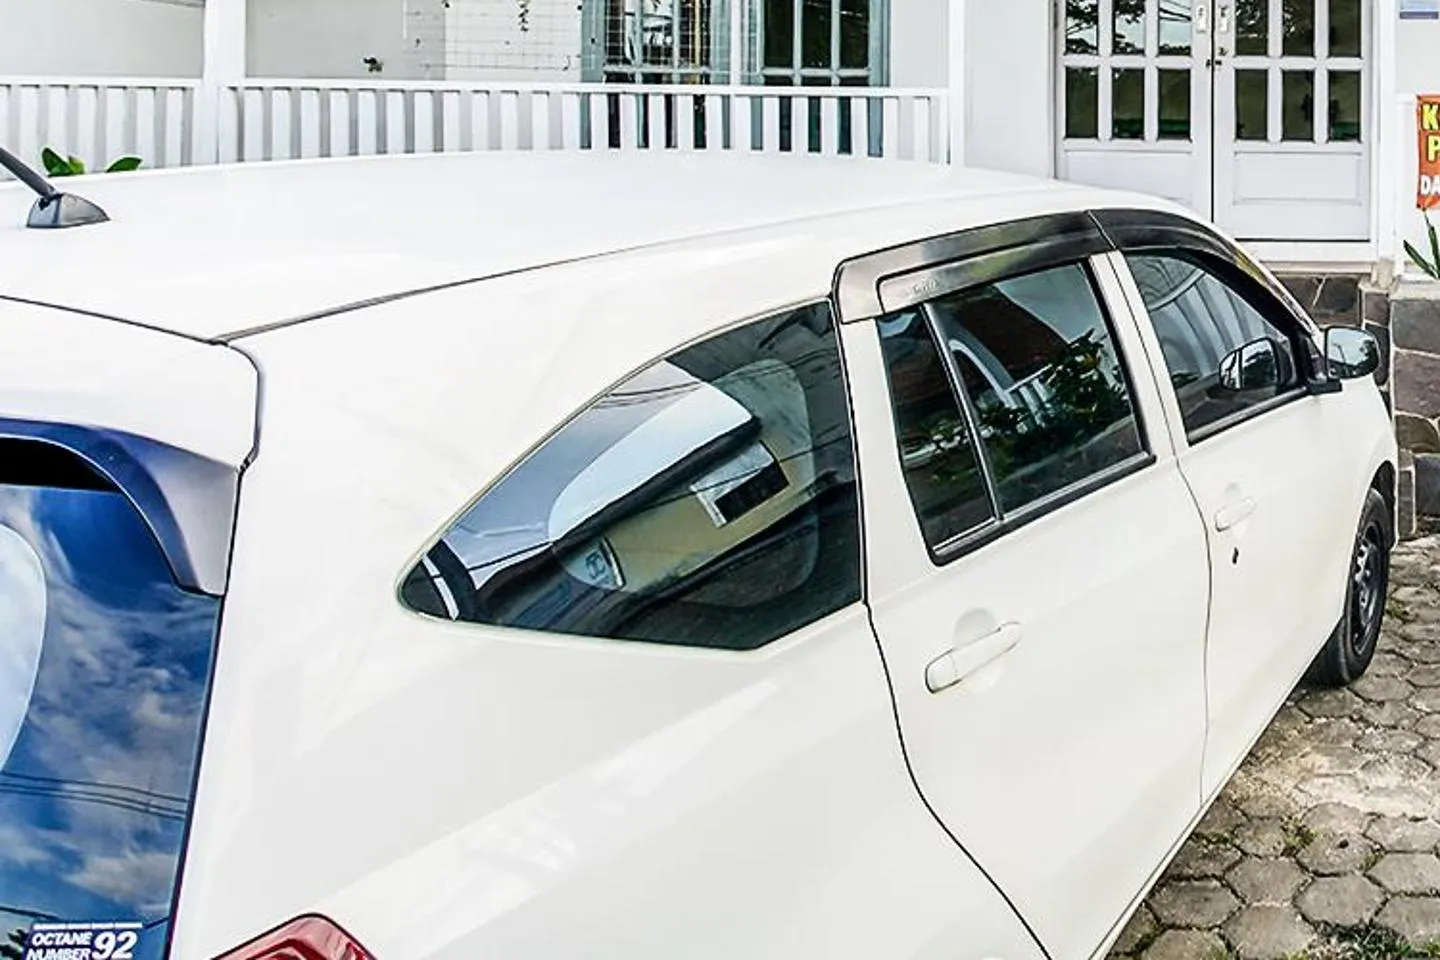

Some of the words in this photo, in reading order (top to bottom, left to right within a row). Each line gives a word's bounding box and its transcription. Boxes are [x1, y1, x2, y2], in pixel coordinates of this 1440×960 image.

[26, 948, 92, 960] NUMBER
[31, 932, 93, 947] OCTANE
[91, 931, 138, 959] 92
